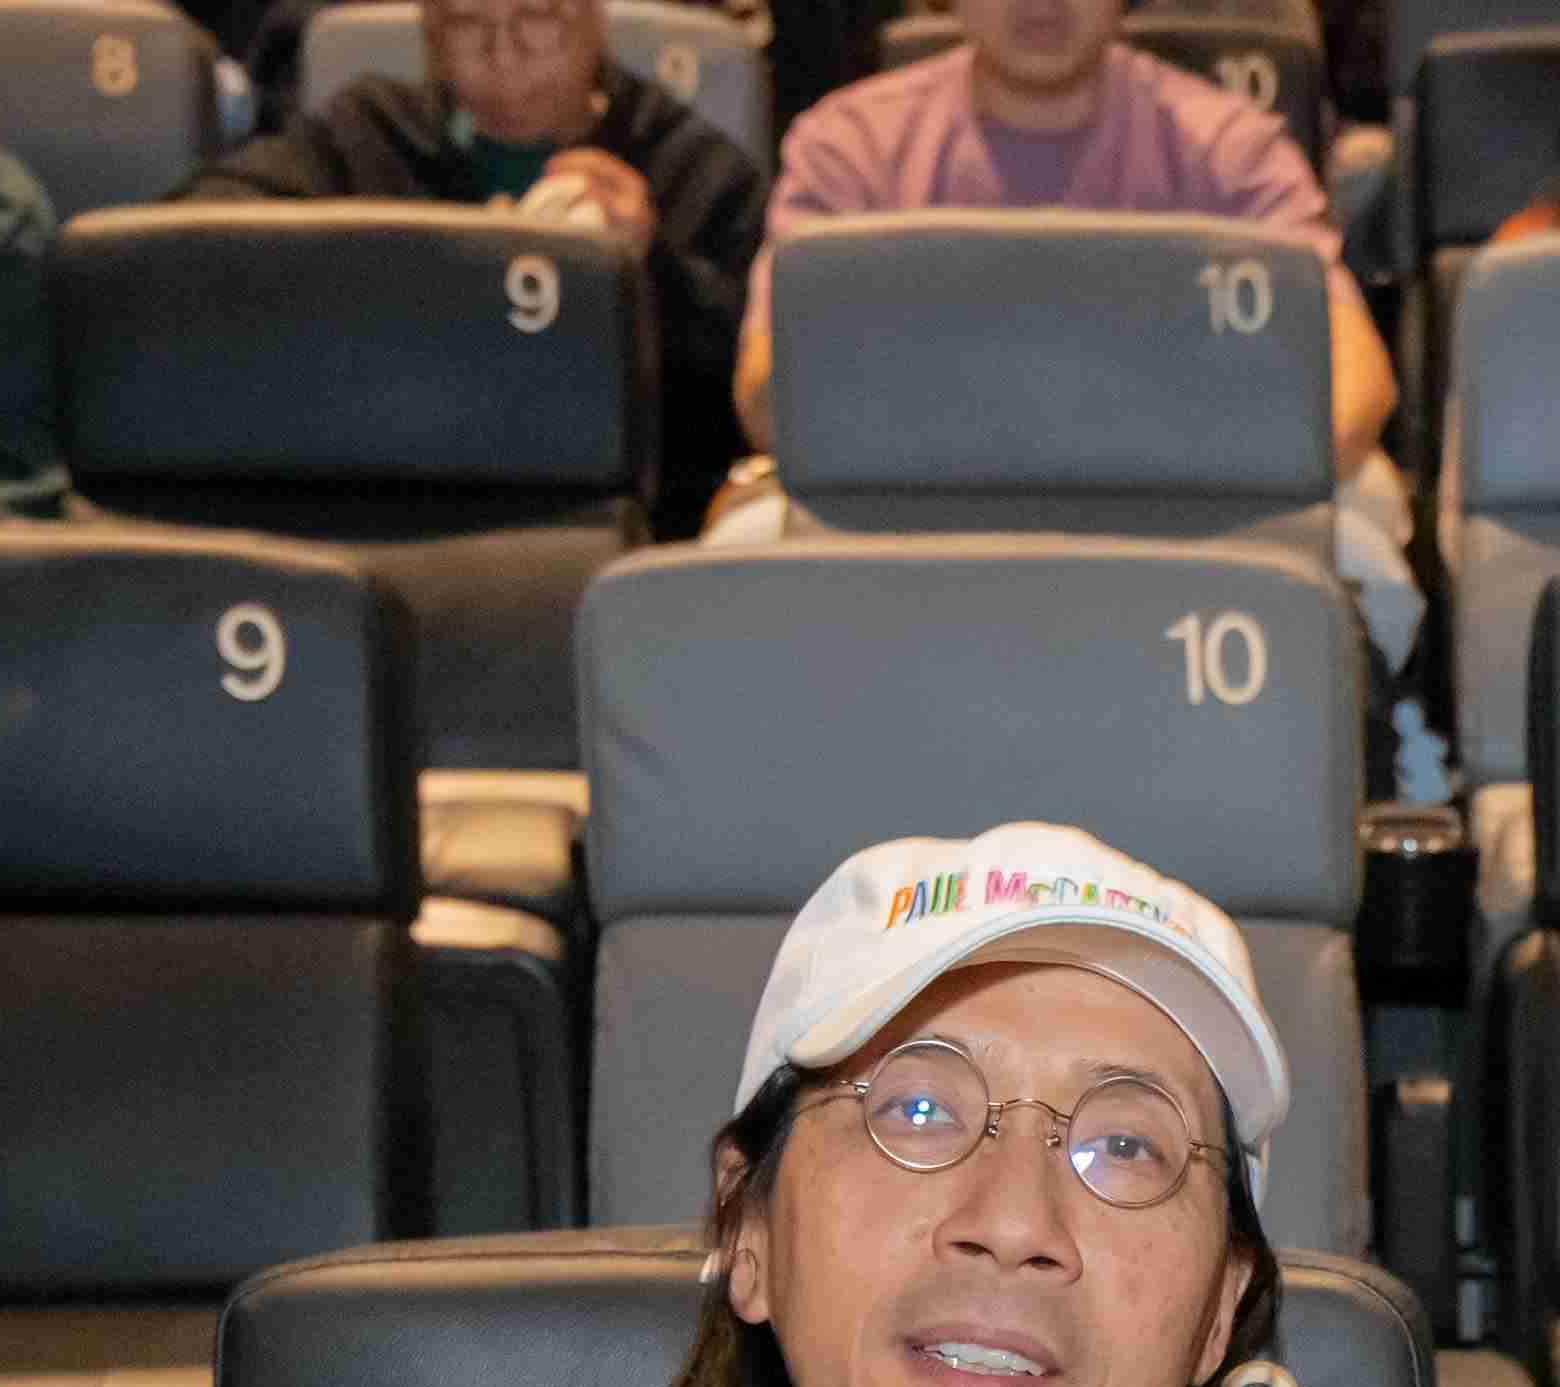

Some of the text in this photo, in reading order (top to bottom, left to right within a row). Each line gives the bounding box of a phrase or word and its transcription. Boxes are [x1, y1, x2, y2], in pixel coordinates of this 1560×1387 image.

[89, 33, 137, 98] 8
[505, 255, 561, 333] 9
[1198, 260, 1273, 336] 10
[216, 603, 285, 701] 9
[1164, 611, 1267, 705] 10
